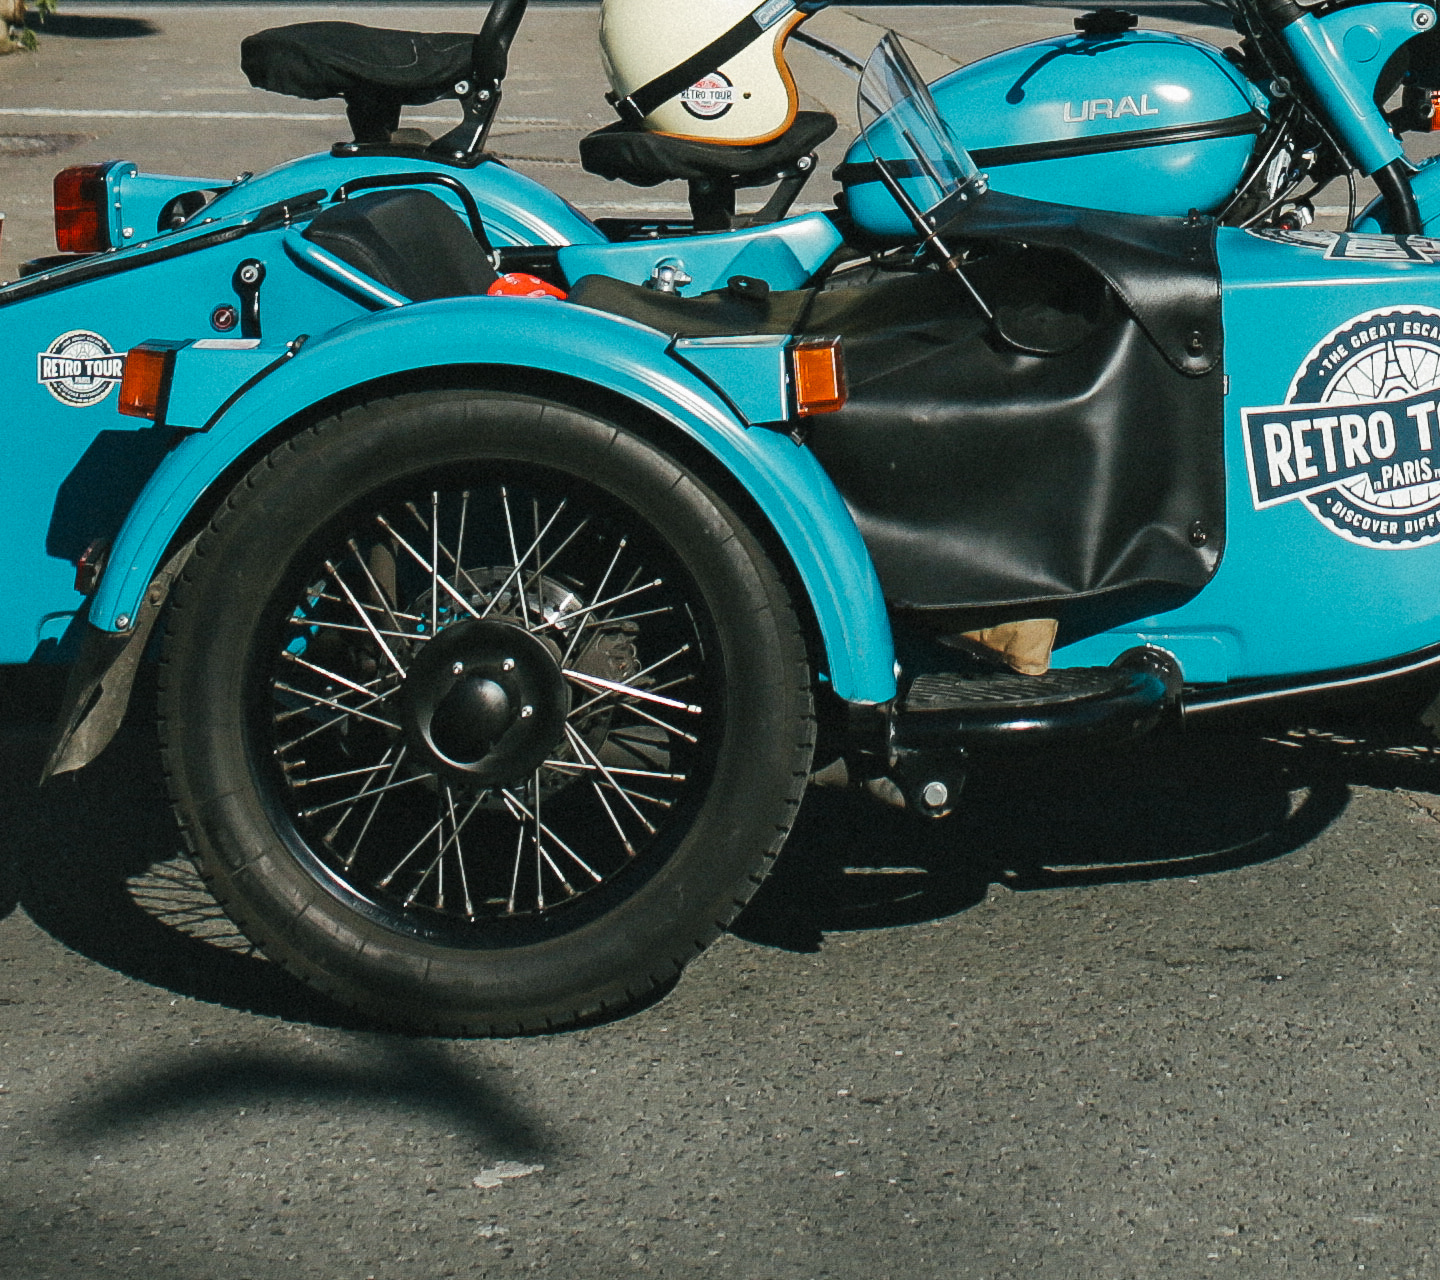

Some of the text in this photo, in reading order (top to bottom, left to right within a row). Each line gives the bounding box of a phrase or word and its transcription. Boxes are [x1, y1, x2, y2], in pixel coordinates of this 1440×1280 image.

[709, 90, 732, 101] TOUR
[1063, 94, 1159, 123] URAL
[1323, 344, 1350, 372] THE
[1351, 322, 1397, 349] GREAT
[43, 358, 123, 378] RETRO TOUR
[1262, 409, 1398, 488] RETRO
[1381, 456, 1433, 490] PARIS
[1332, 500, 1399, 535] DISCOVER
